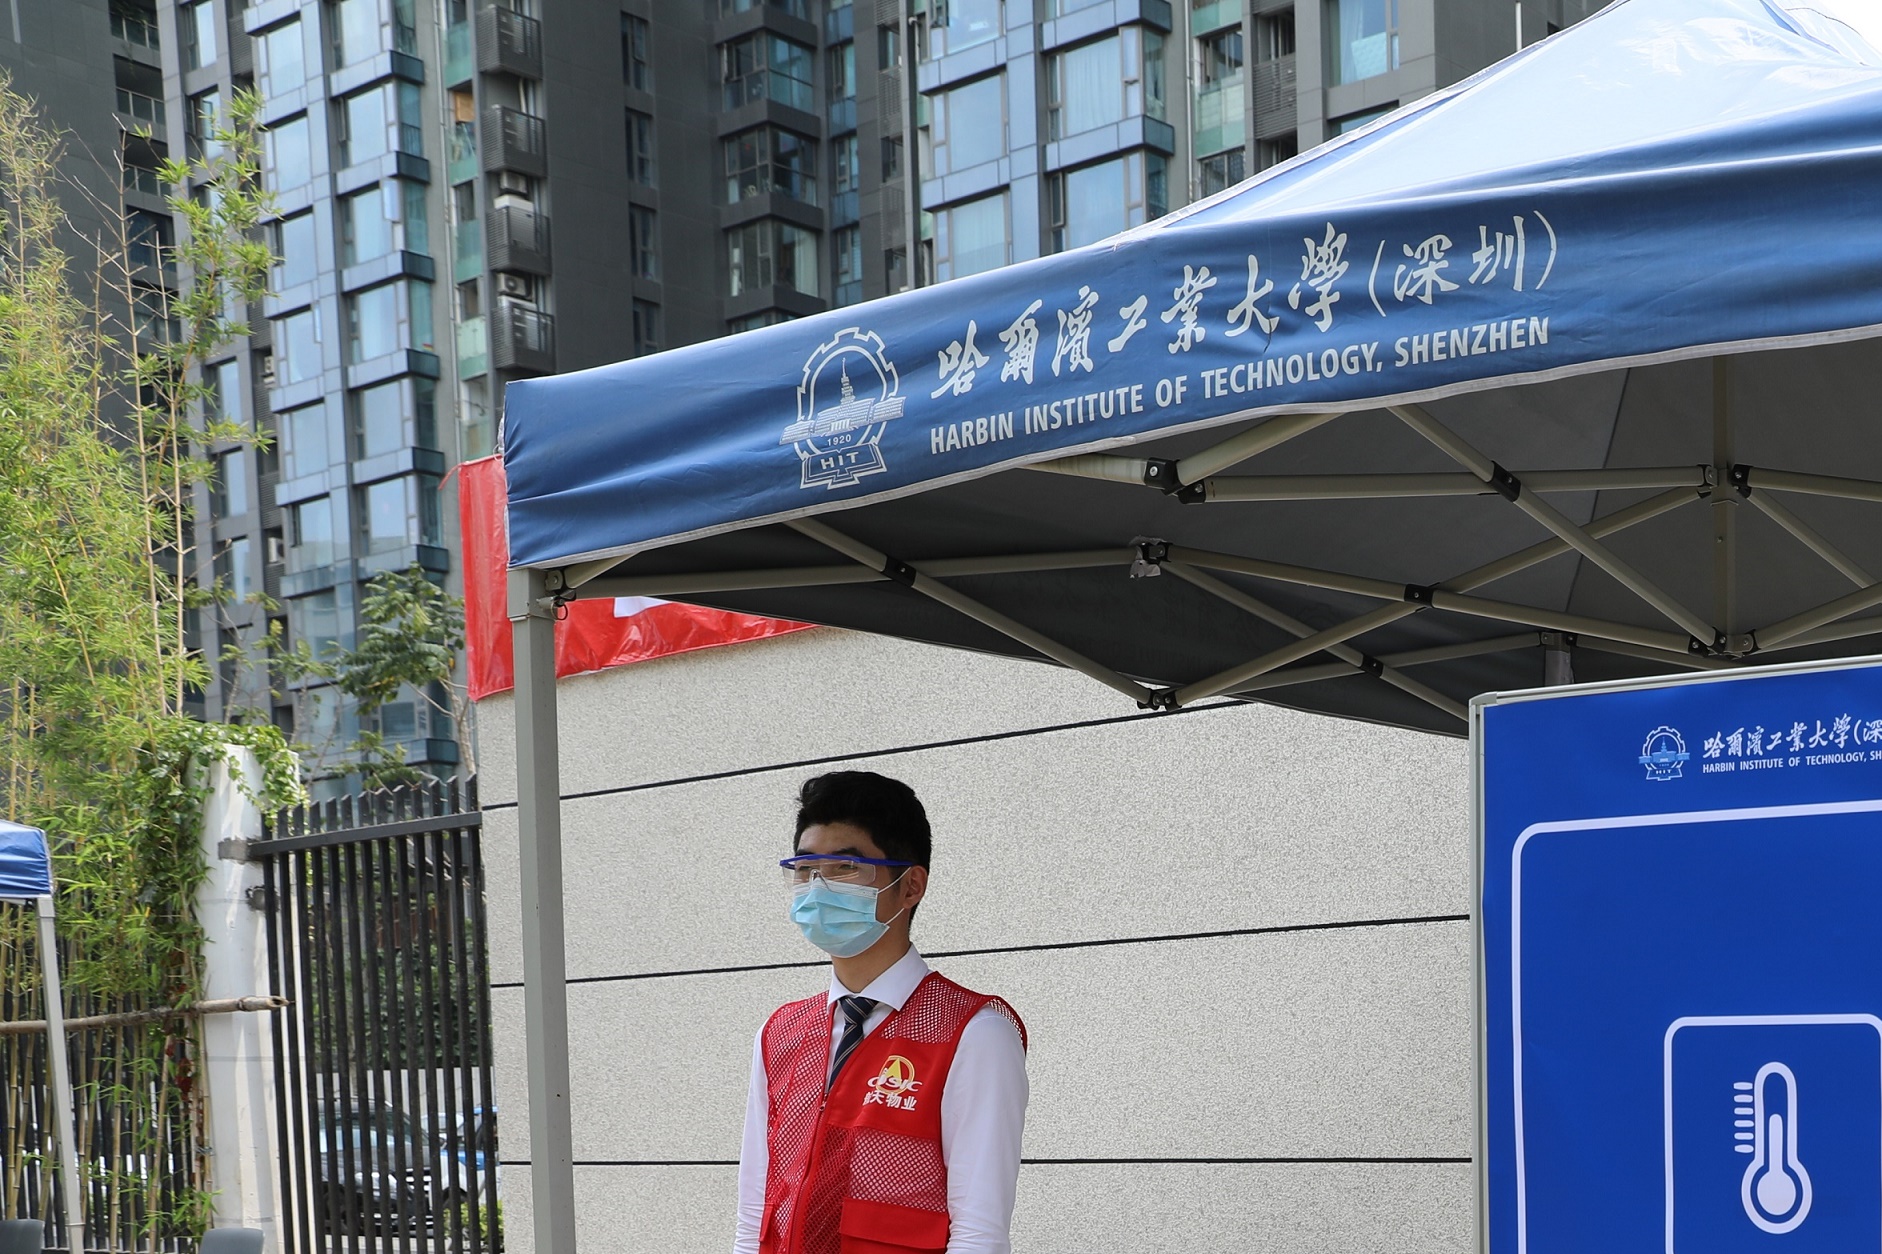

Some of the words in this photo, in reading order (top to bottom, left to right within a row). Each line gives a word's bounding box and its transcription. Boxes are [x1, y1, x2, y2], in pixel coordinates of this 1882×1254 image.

[930, 411, 1014, 455] HARBIN
[1023, 384, 1144, 435] INSTITUTE
[1155, 375, 1188, 408] OF
[1200, 341, 1384, 400] TECHNOLOGY,
[1395, 316, 1550, 368] SHENZHEN
[827, 433, 852, 447] 1920
[820, 451, 859, 470] HIT
[1702, 762, 1736, 775] HARBIN
[1739, 757, 1784, 771] INSTITUTE
[1788, 756, 1802, 768] OF
[1805, 748, 1868, 767] TECHNOLOGY,
